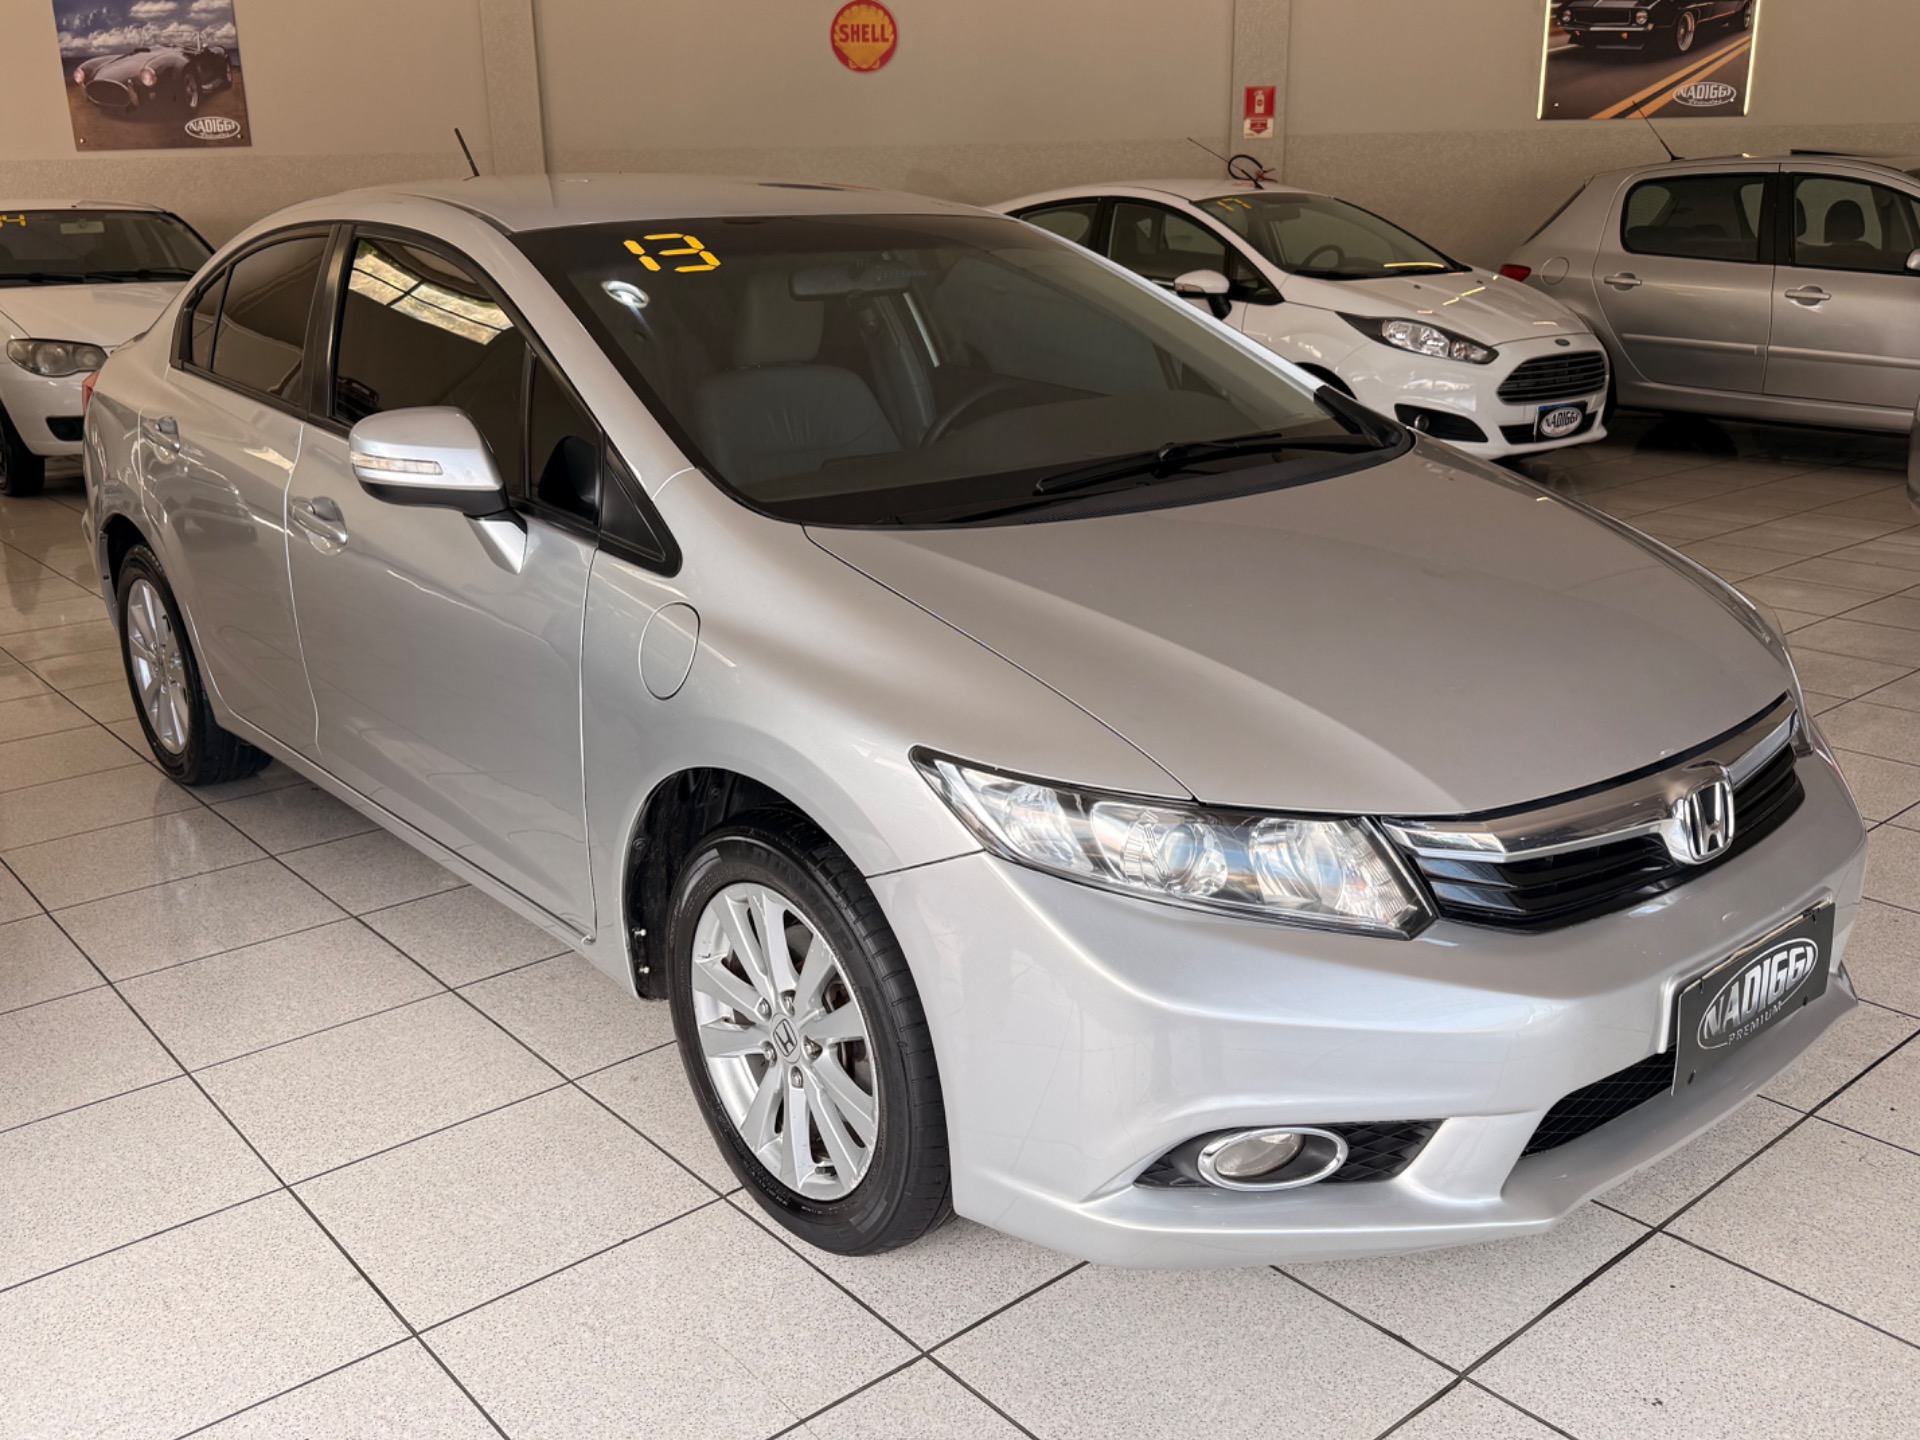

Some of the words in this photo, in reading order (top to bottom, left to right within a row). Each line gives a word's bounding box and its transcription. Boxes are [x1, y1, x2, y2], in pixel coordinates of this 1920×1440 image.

[839, 24, 890, 43] SHELL
[1677, 84, 1732, 99] NADIGGI
[623, 232, 722, 273] 13
[1703, 946, 1815, 1040] NADIGGI
[1727, 1000, 1785, 1045] PREMIUM
